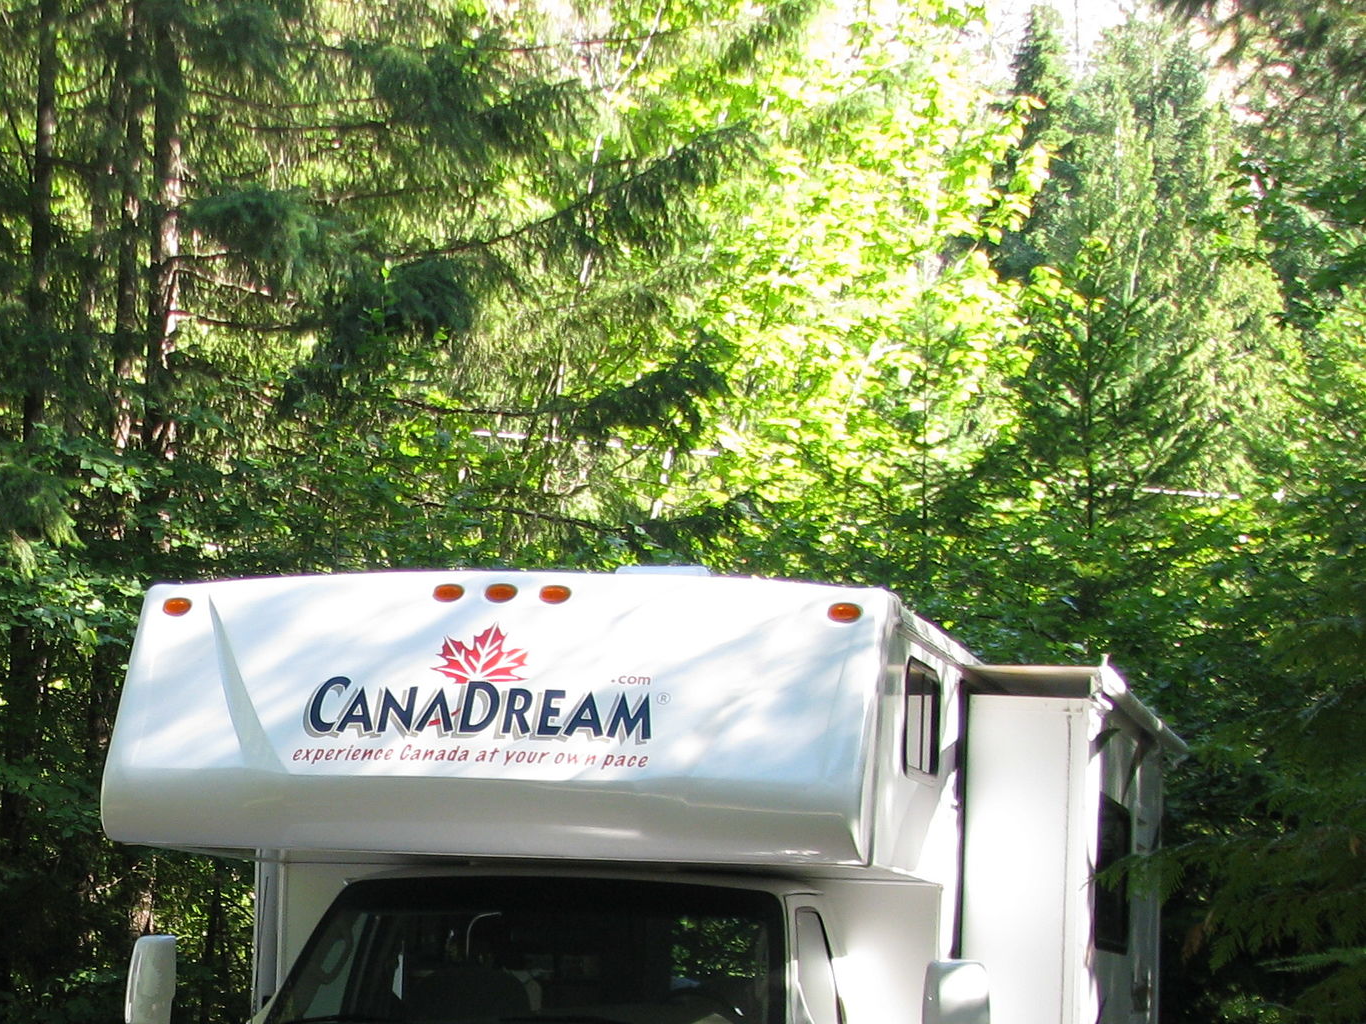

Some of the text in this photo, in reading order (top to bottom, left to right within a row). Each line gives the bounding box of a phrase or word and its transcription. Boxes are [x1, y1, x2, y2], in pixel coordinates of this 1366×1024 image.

[292, 743, 650, 770] experience Canada at your own pace
